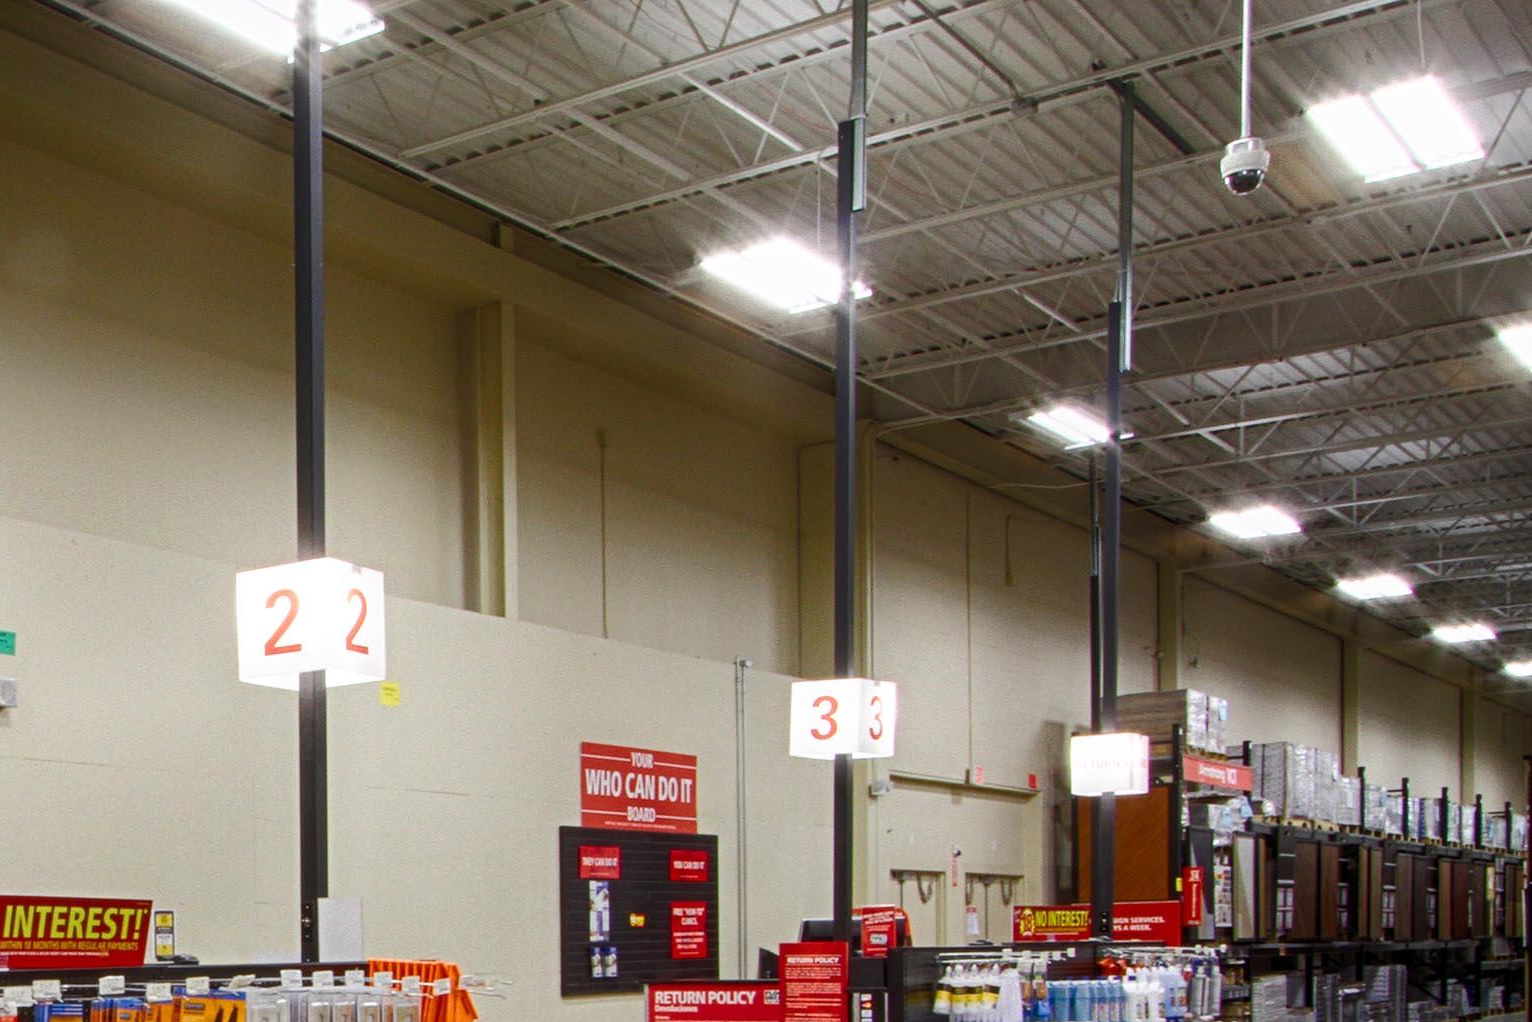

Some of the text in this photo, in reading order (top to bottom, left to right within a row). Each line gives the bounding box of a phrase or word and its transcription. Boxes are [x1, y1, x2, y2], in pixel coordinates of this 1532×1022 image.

[264, 589, 302, 656] 2
[345, 588, 369, 655] 2
[810, 695, 839, 740] 3
[868, 695, 883, 741] 3
[631, 752, 654, 768] YOUR
[585, 769, 692, 803] WHO CAN DO IT
[627, 806, 656, 823] BOARD
[3, 904, 144, 940] INTEREST!
[1035, 910, 1046, 926] NO
[654, 991, 756, 1005] RETURN POLICY
